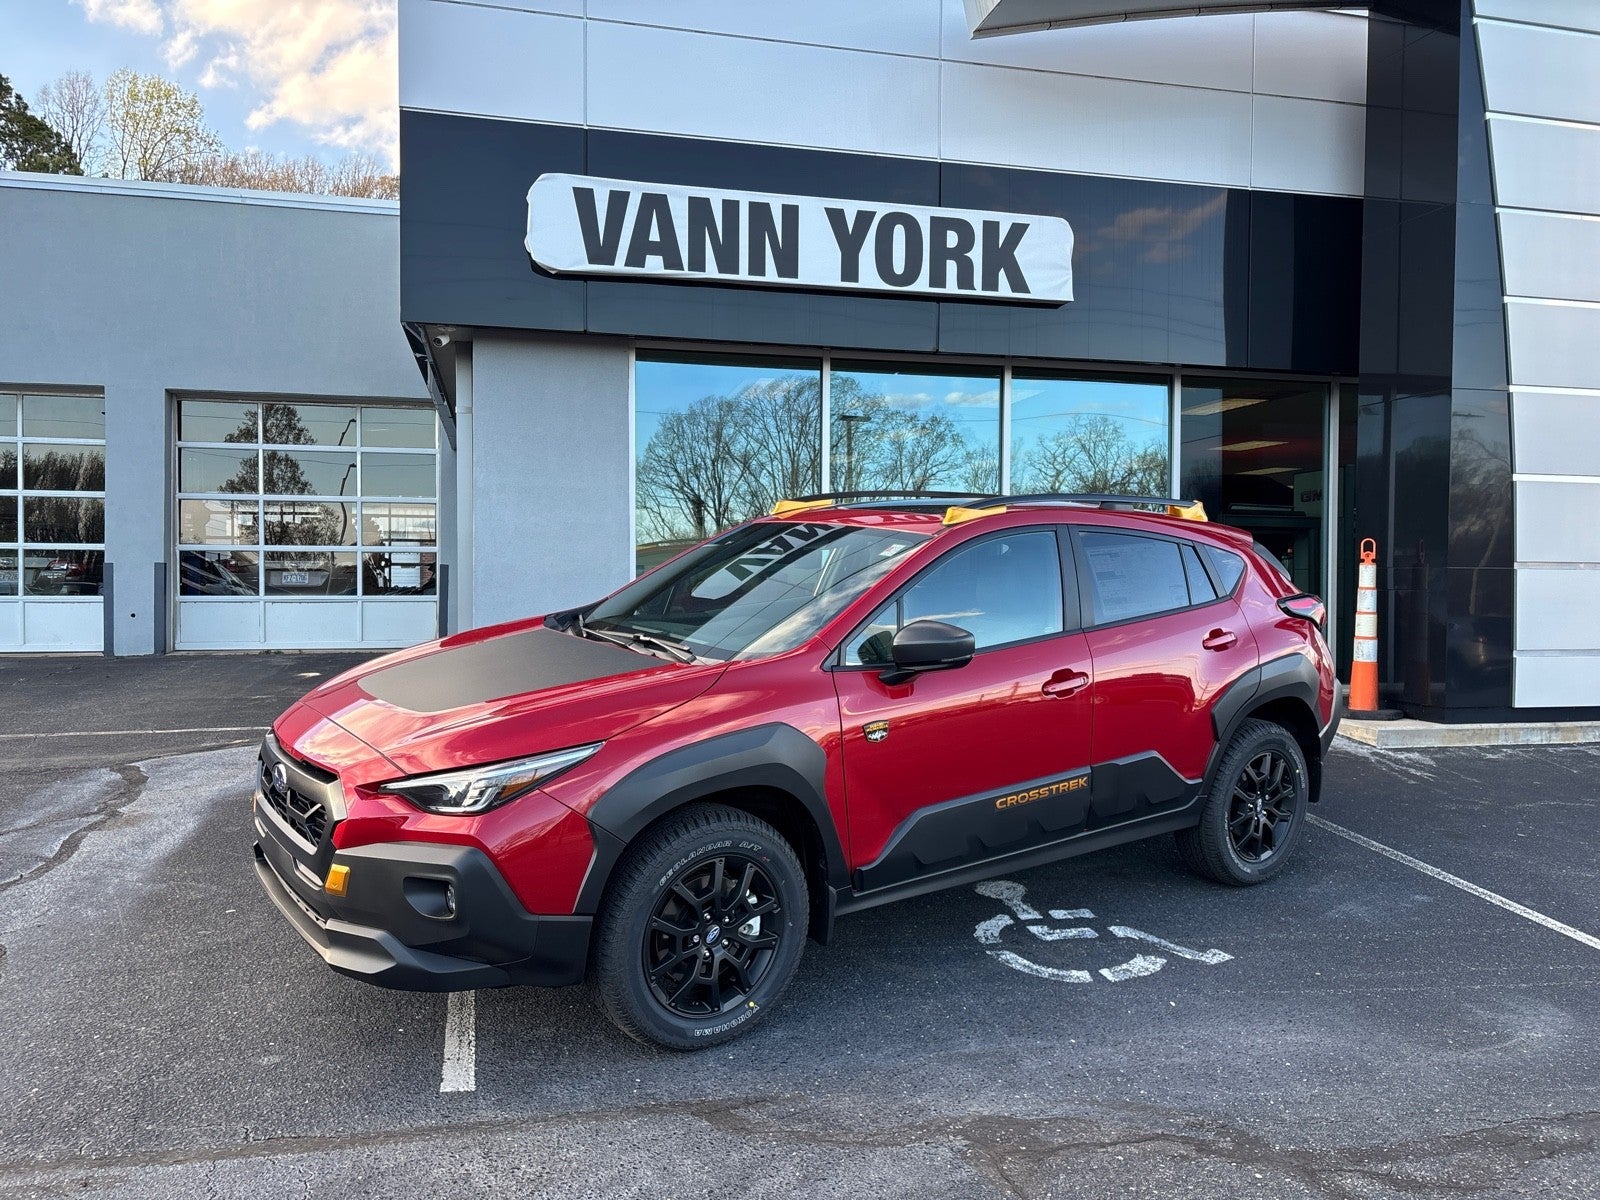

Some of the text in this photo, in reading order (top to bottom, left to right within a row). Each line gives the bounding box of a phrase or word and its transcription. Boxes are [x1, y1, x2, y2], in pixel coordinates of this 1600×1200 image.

[572, 186, 1031, 295] VANN YORK
[994, 776, 1089, 810] CROSSTREK
[659, 840, 762, 887] GEOLANDAR A/T
[694, 1004, 760, 1037] YOKOHAMA
